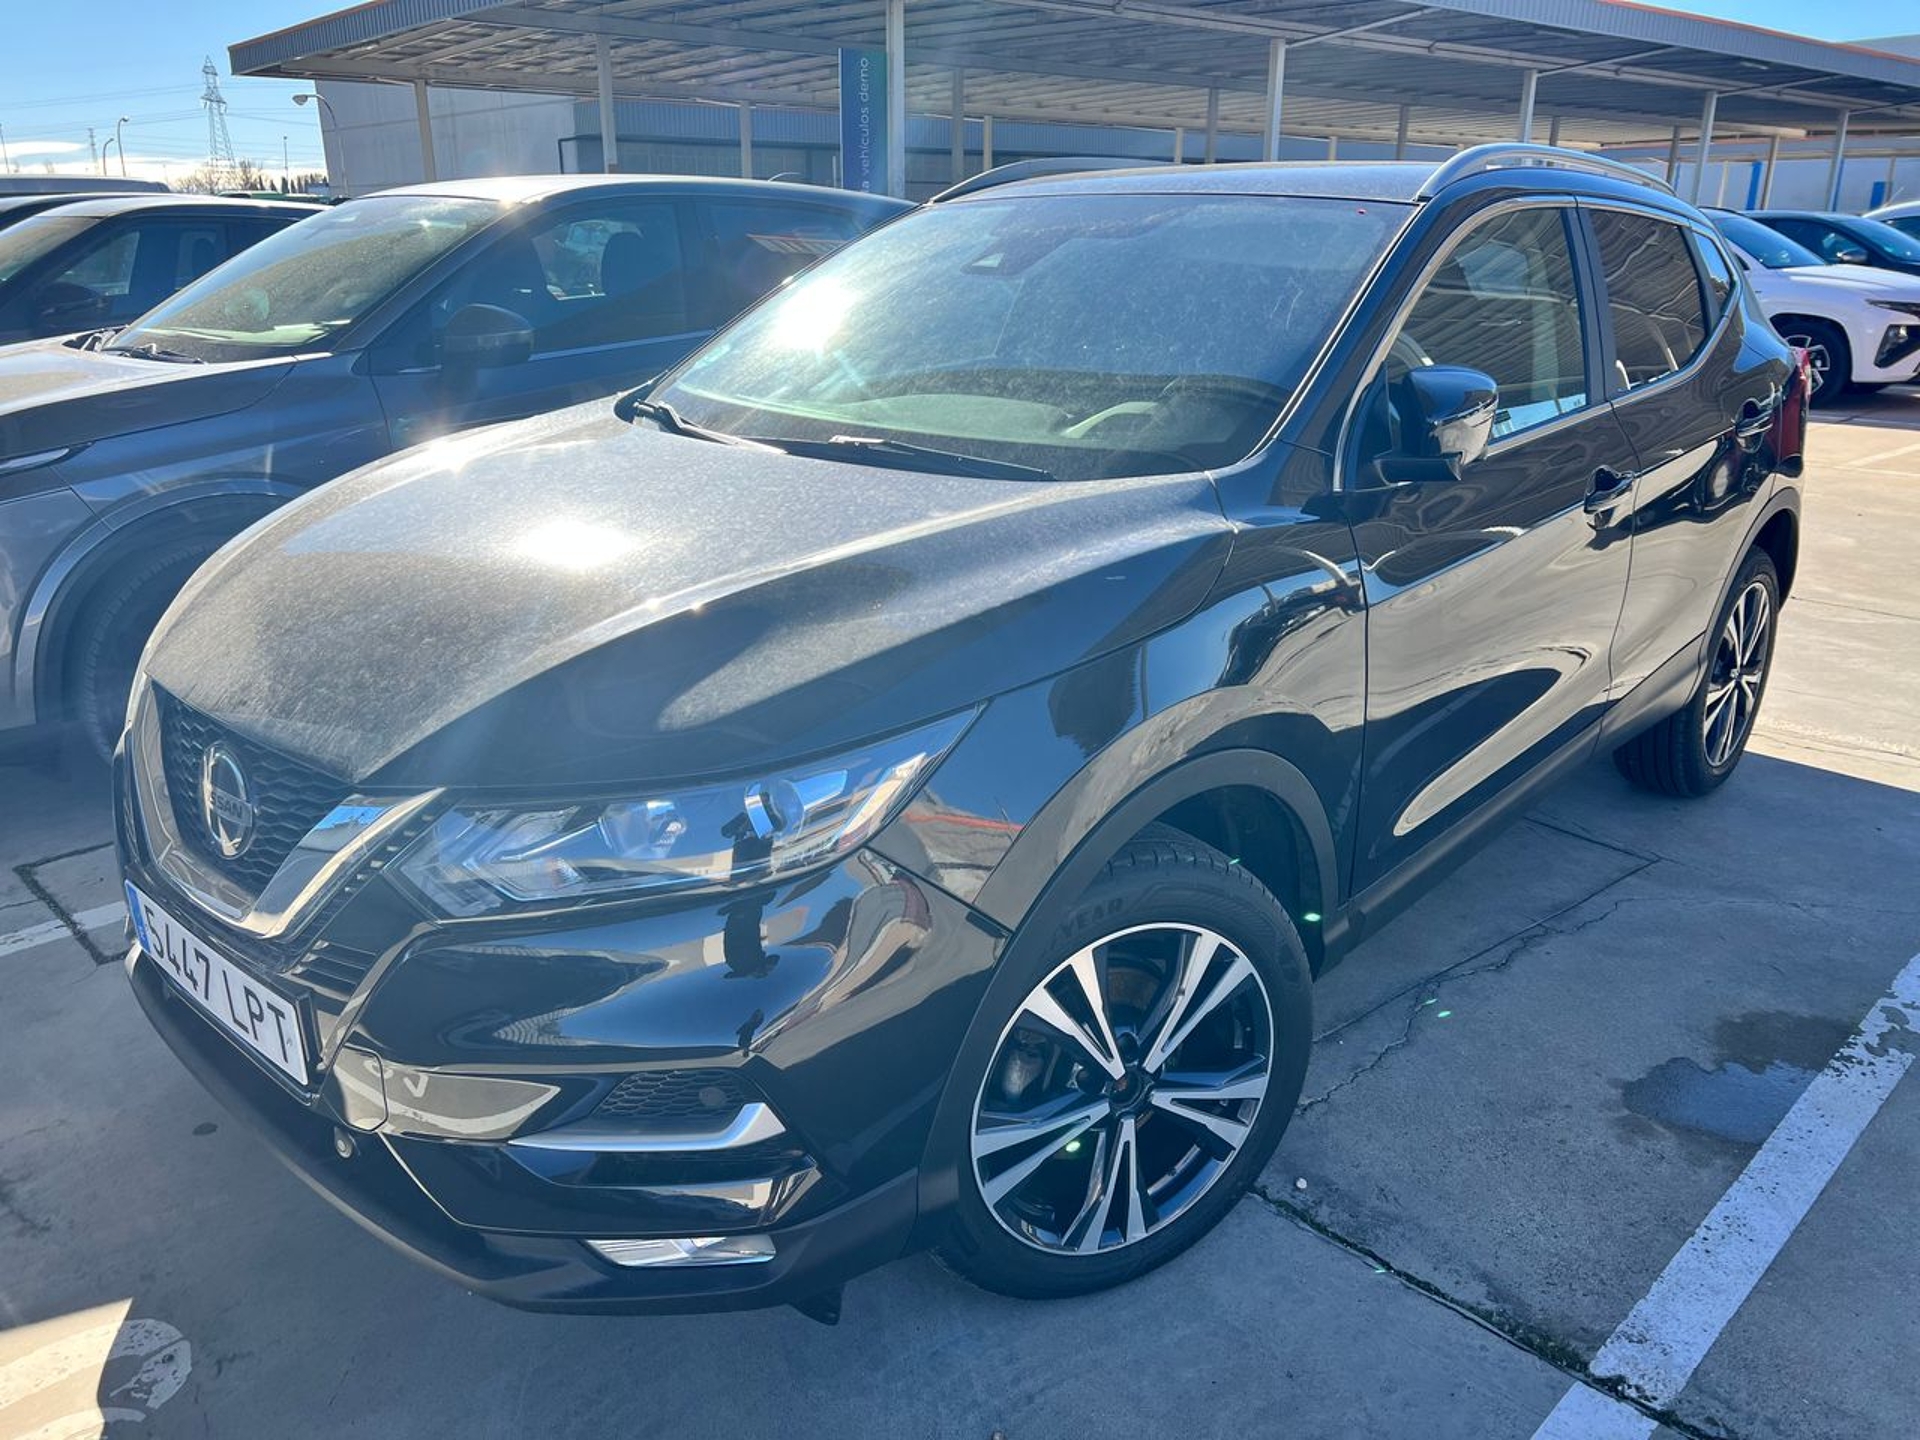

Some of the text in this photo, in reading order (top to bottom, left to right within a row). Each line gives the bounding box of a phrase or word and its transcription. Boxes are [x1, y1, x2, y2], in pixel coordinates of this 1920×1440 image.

[860, 58, 869, 101] demo
[144, 904, 288, 1063] 5447 LPT
